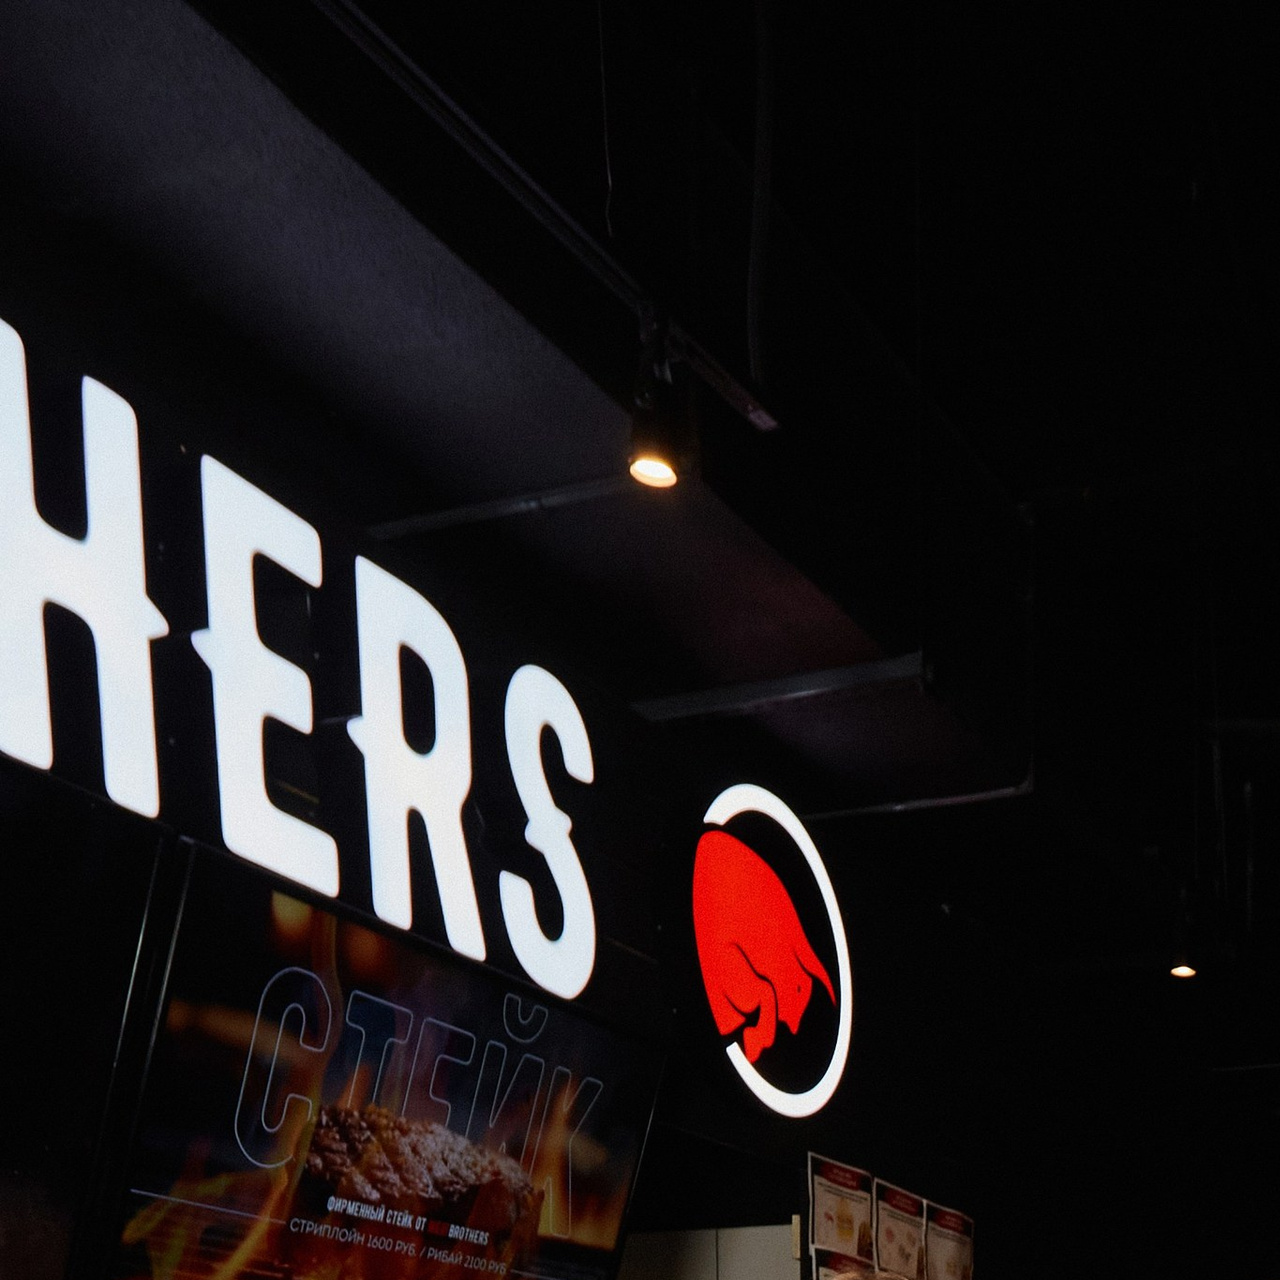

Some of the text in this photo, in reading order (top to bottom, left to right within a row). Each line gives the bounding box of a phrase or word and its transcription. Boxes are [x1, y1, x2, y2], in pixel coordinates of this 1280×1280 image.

[0, 317, 598, 1000] HERS
[327, 1195, 385, 1222] ФИРМЕННЫЙ
[386, 1209, 413, 1229] СТЕЙК
[415, 1216, 427, 1231] ОТ
[289, 1217, 365, 1246] СТРИПЛОЙН
[367, 1234, 393, 1252] 1600
[427, 1247, 463, 1265] РИБАЙ
[463, 1255, 487, 1271] 2100
